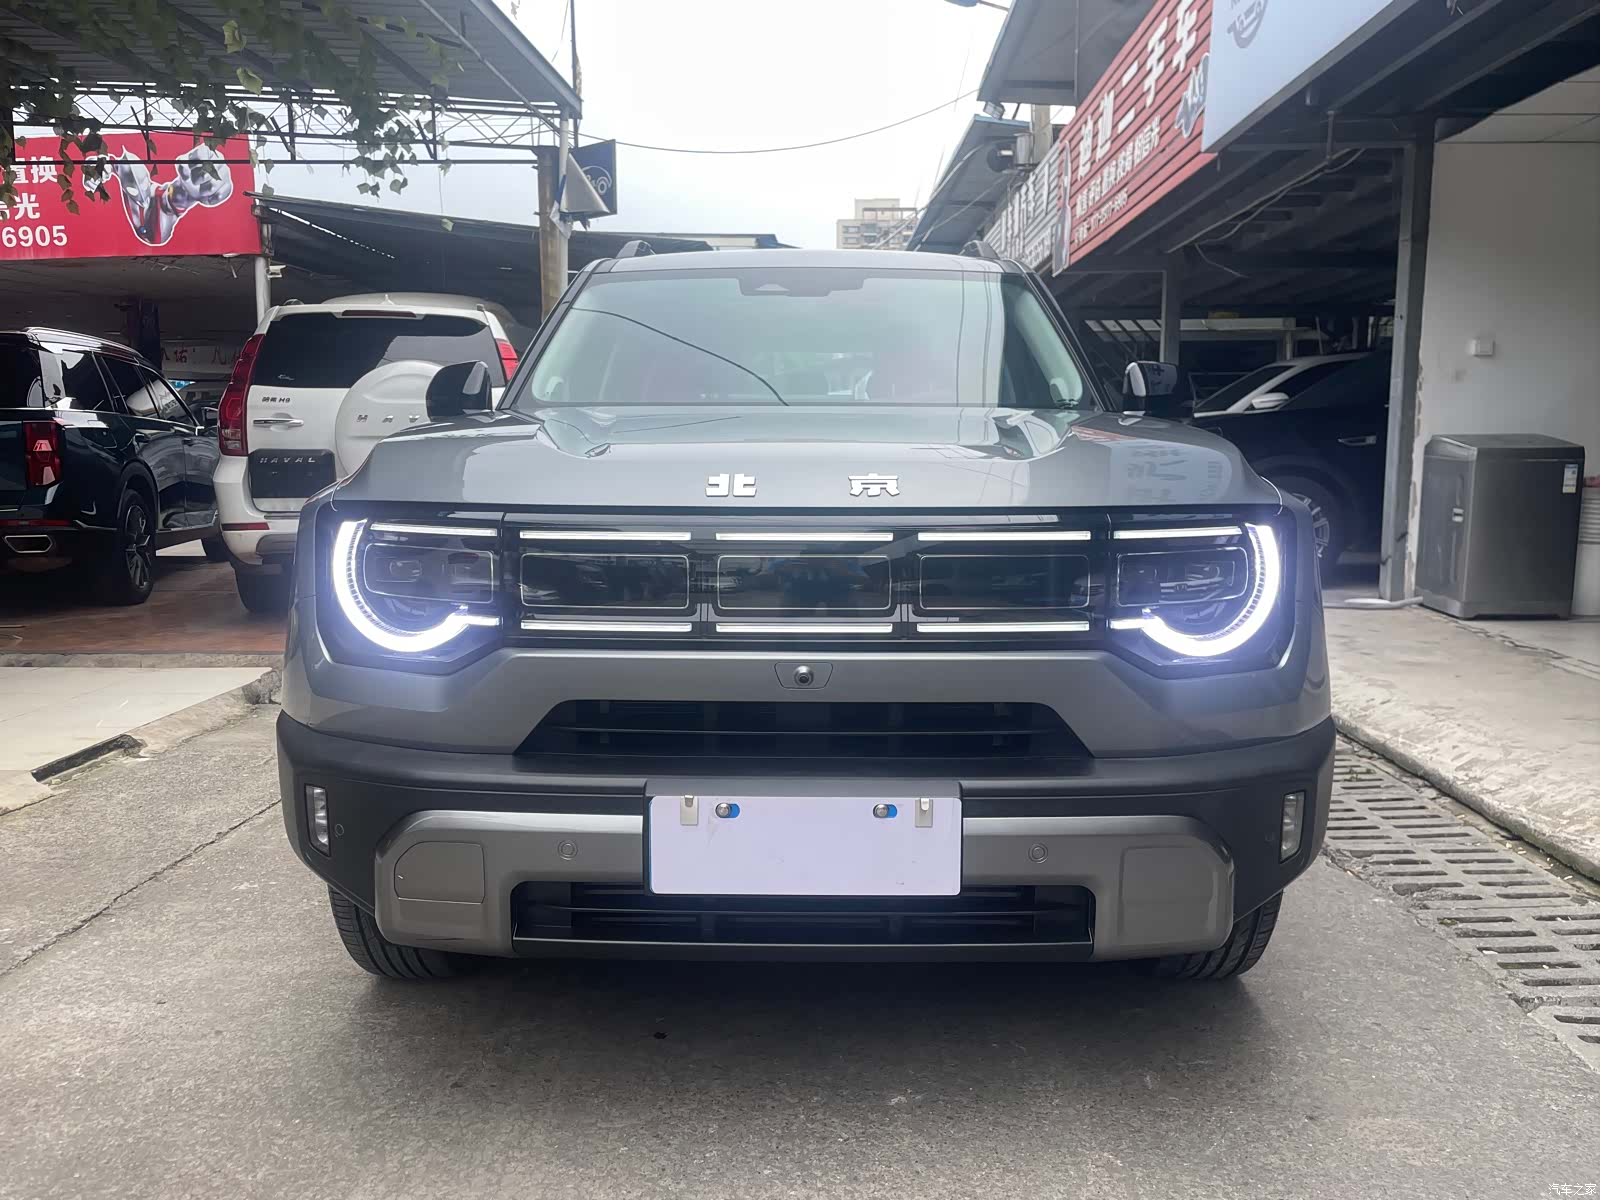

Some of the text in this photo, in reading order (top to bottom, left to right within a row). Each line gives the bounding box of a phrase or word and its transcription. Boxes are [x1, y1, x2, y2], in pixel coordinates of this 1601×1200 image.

[1, 225, 68, 248] 6905
[259, 456, 316, 464] HAVAL
[705, 473, 900, 497] 北京
